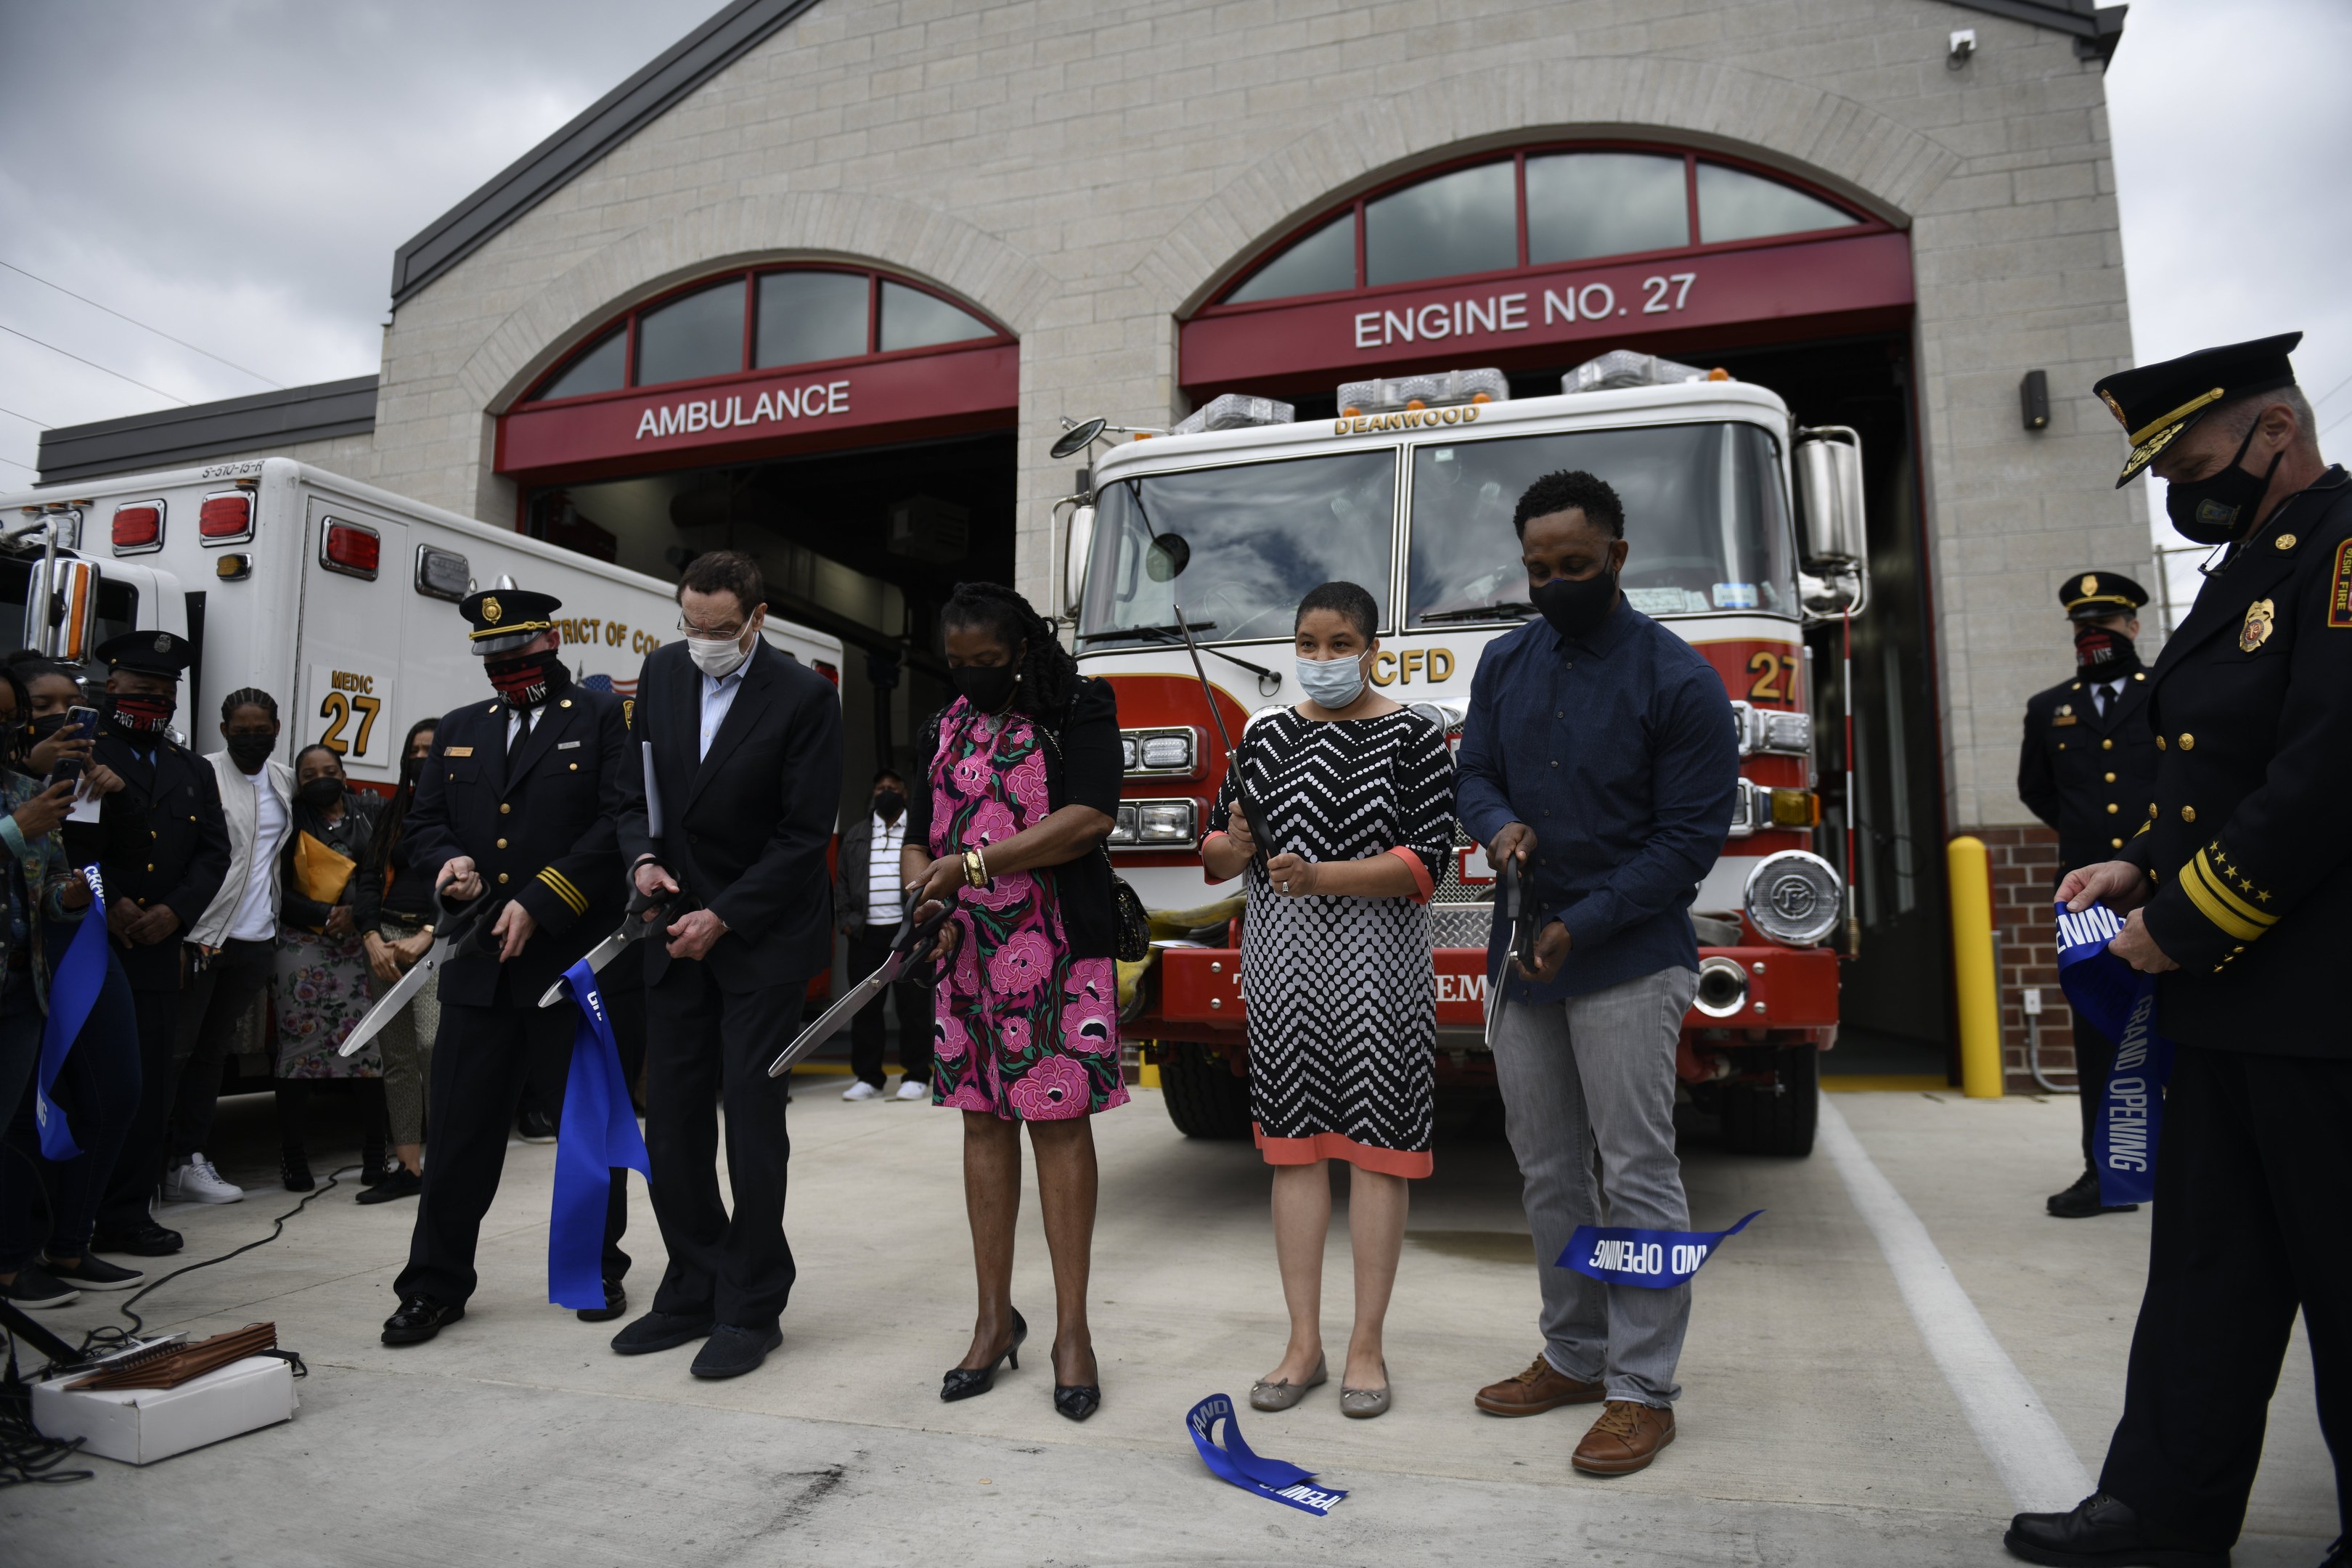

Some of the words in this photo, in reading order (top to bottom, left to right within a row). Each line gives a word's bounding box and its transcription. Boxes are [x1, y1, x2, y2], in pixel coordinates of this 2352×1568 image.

[1355, 293, 1529, 348] ENGINE
[1544, 283, 1627, 324] NO.
[1642, 273, 1696, 313] 27
[635, 380, 850, 440] AMBULANCE
[1335, 406, 1479, 436] DEANWOOD
[203, 460, 265, 478] S-510-15-R
[2337, 581, 2350, 611] FIRE
[552, 618, 600, 645] TRICT
[605, 621, 627, 648] OF
[331, 670, 373, 695] MEDIC
[1369, 648, 1455, 687] CFD
[1746, 650, 1800, 705] 27
[319, 691, 380, 758] 27
[83, 865, 106, 912] GRA
[2114, 994, 2153, 1071] GRAND
[2109, 1077, 2147, 1172] OPENING
[1588, 1239, 1663, 1275] OPENING
[1192, 1400, 1229, 1440] AND
